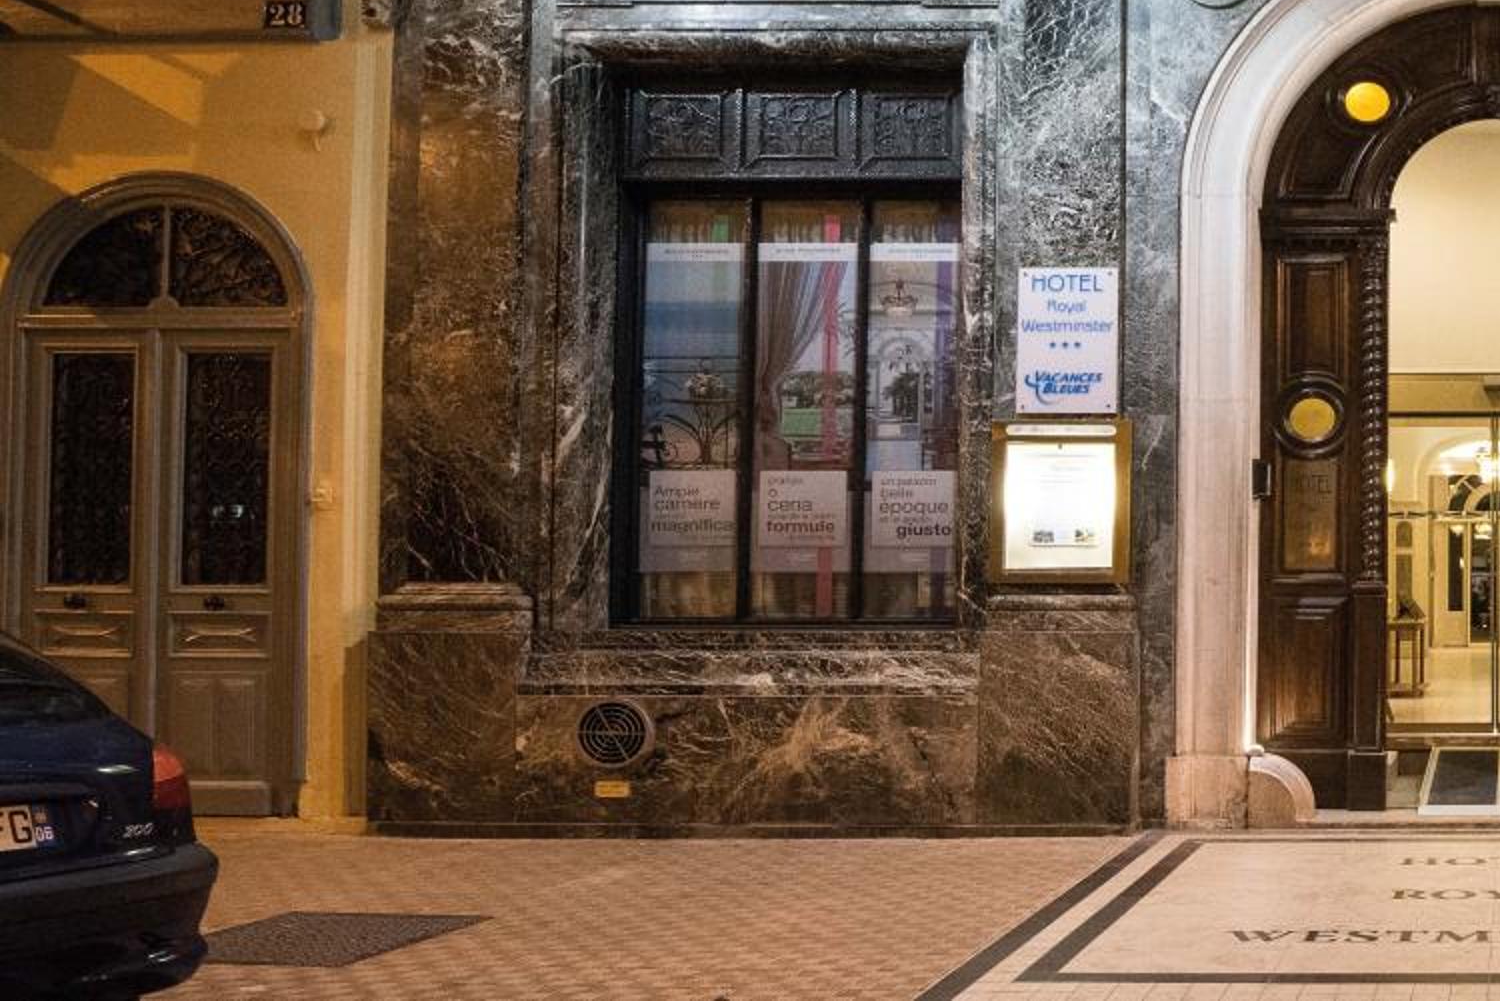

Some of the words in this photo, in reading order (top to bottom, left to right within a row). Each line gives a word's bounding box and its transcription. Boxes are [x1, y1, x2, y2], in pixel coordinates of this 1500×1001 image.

[269, 4, 303, 26] 28
[1032, 274, 1103, 292] HOTEL
[1047, 300, 1087, 313] Royal
[1022, 320, 1113, 333] Westminster
[896, 522, 952, 540] giusto
